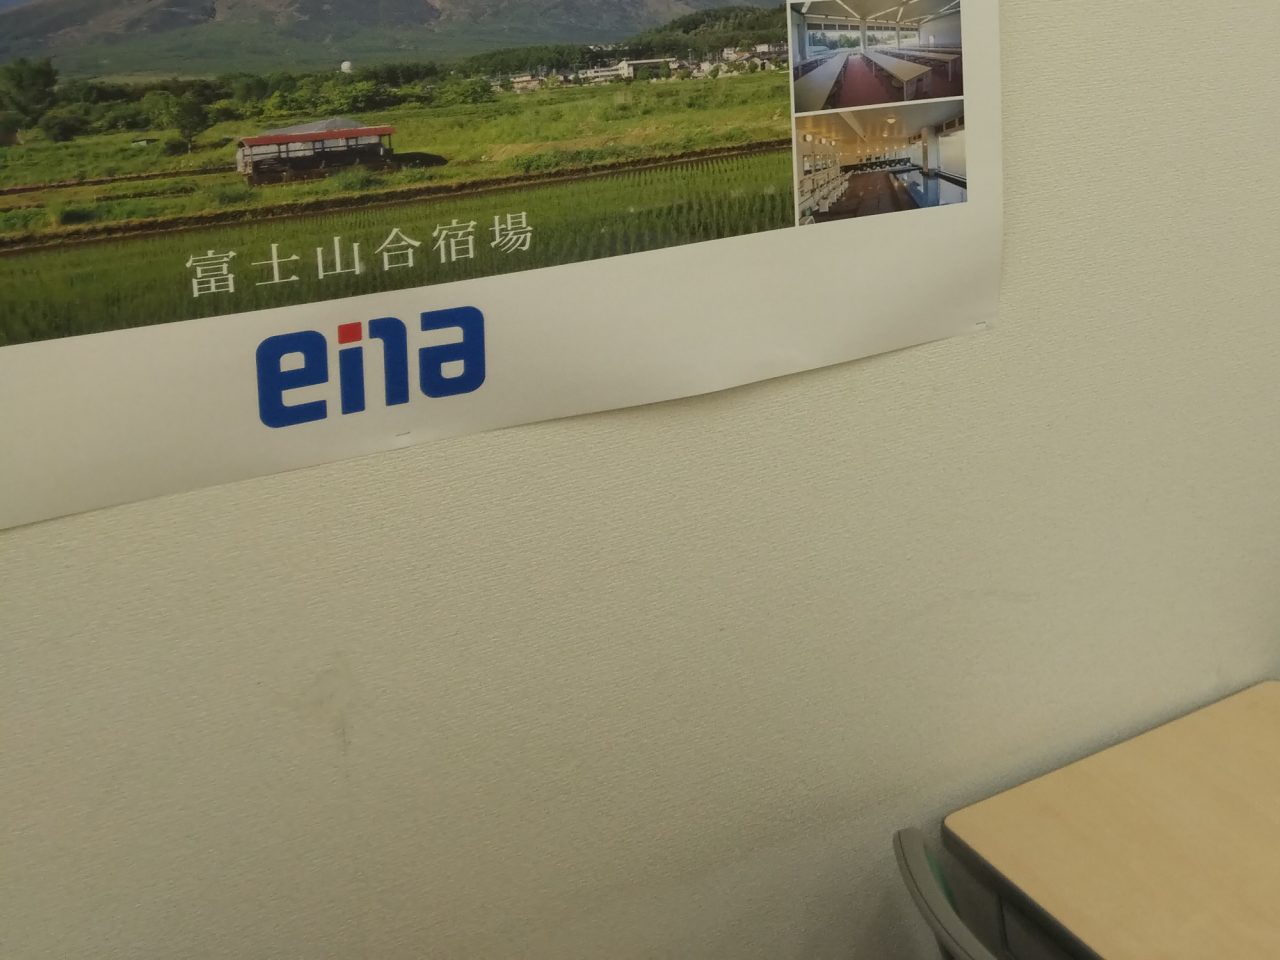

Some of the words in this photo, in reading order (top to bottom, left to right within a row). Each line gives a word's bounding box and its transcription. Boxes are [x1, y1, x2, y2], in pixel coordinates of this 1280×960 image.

[185, 211, 534, 298] 富士山合宿場
[255, 305, 487, 429] ena
